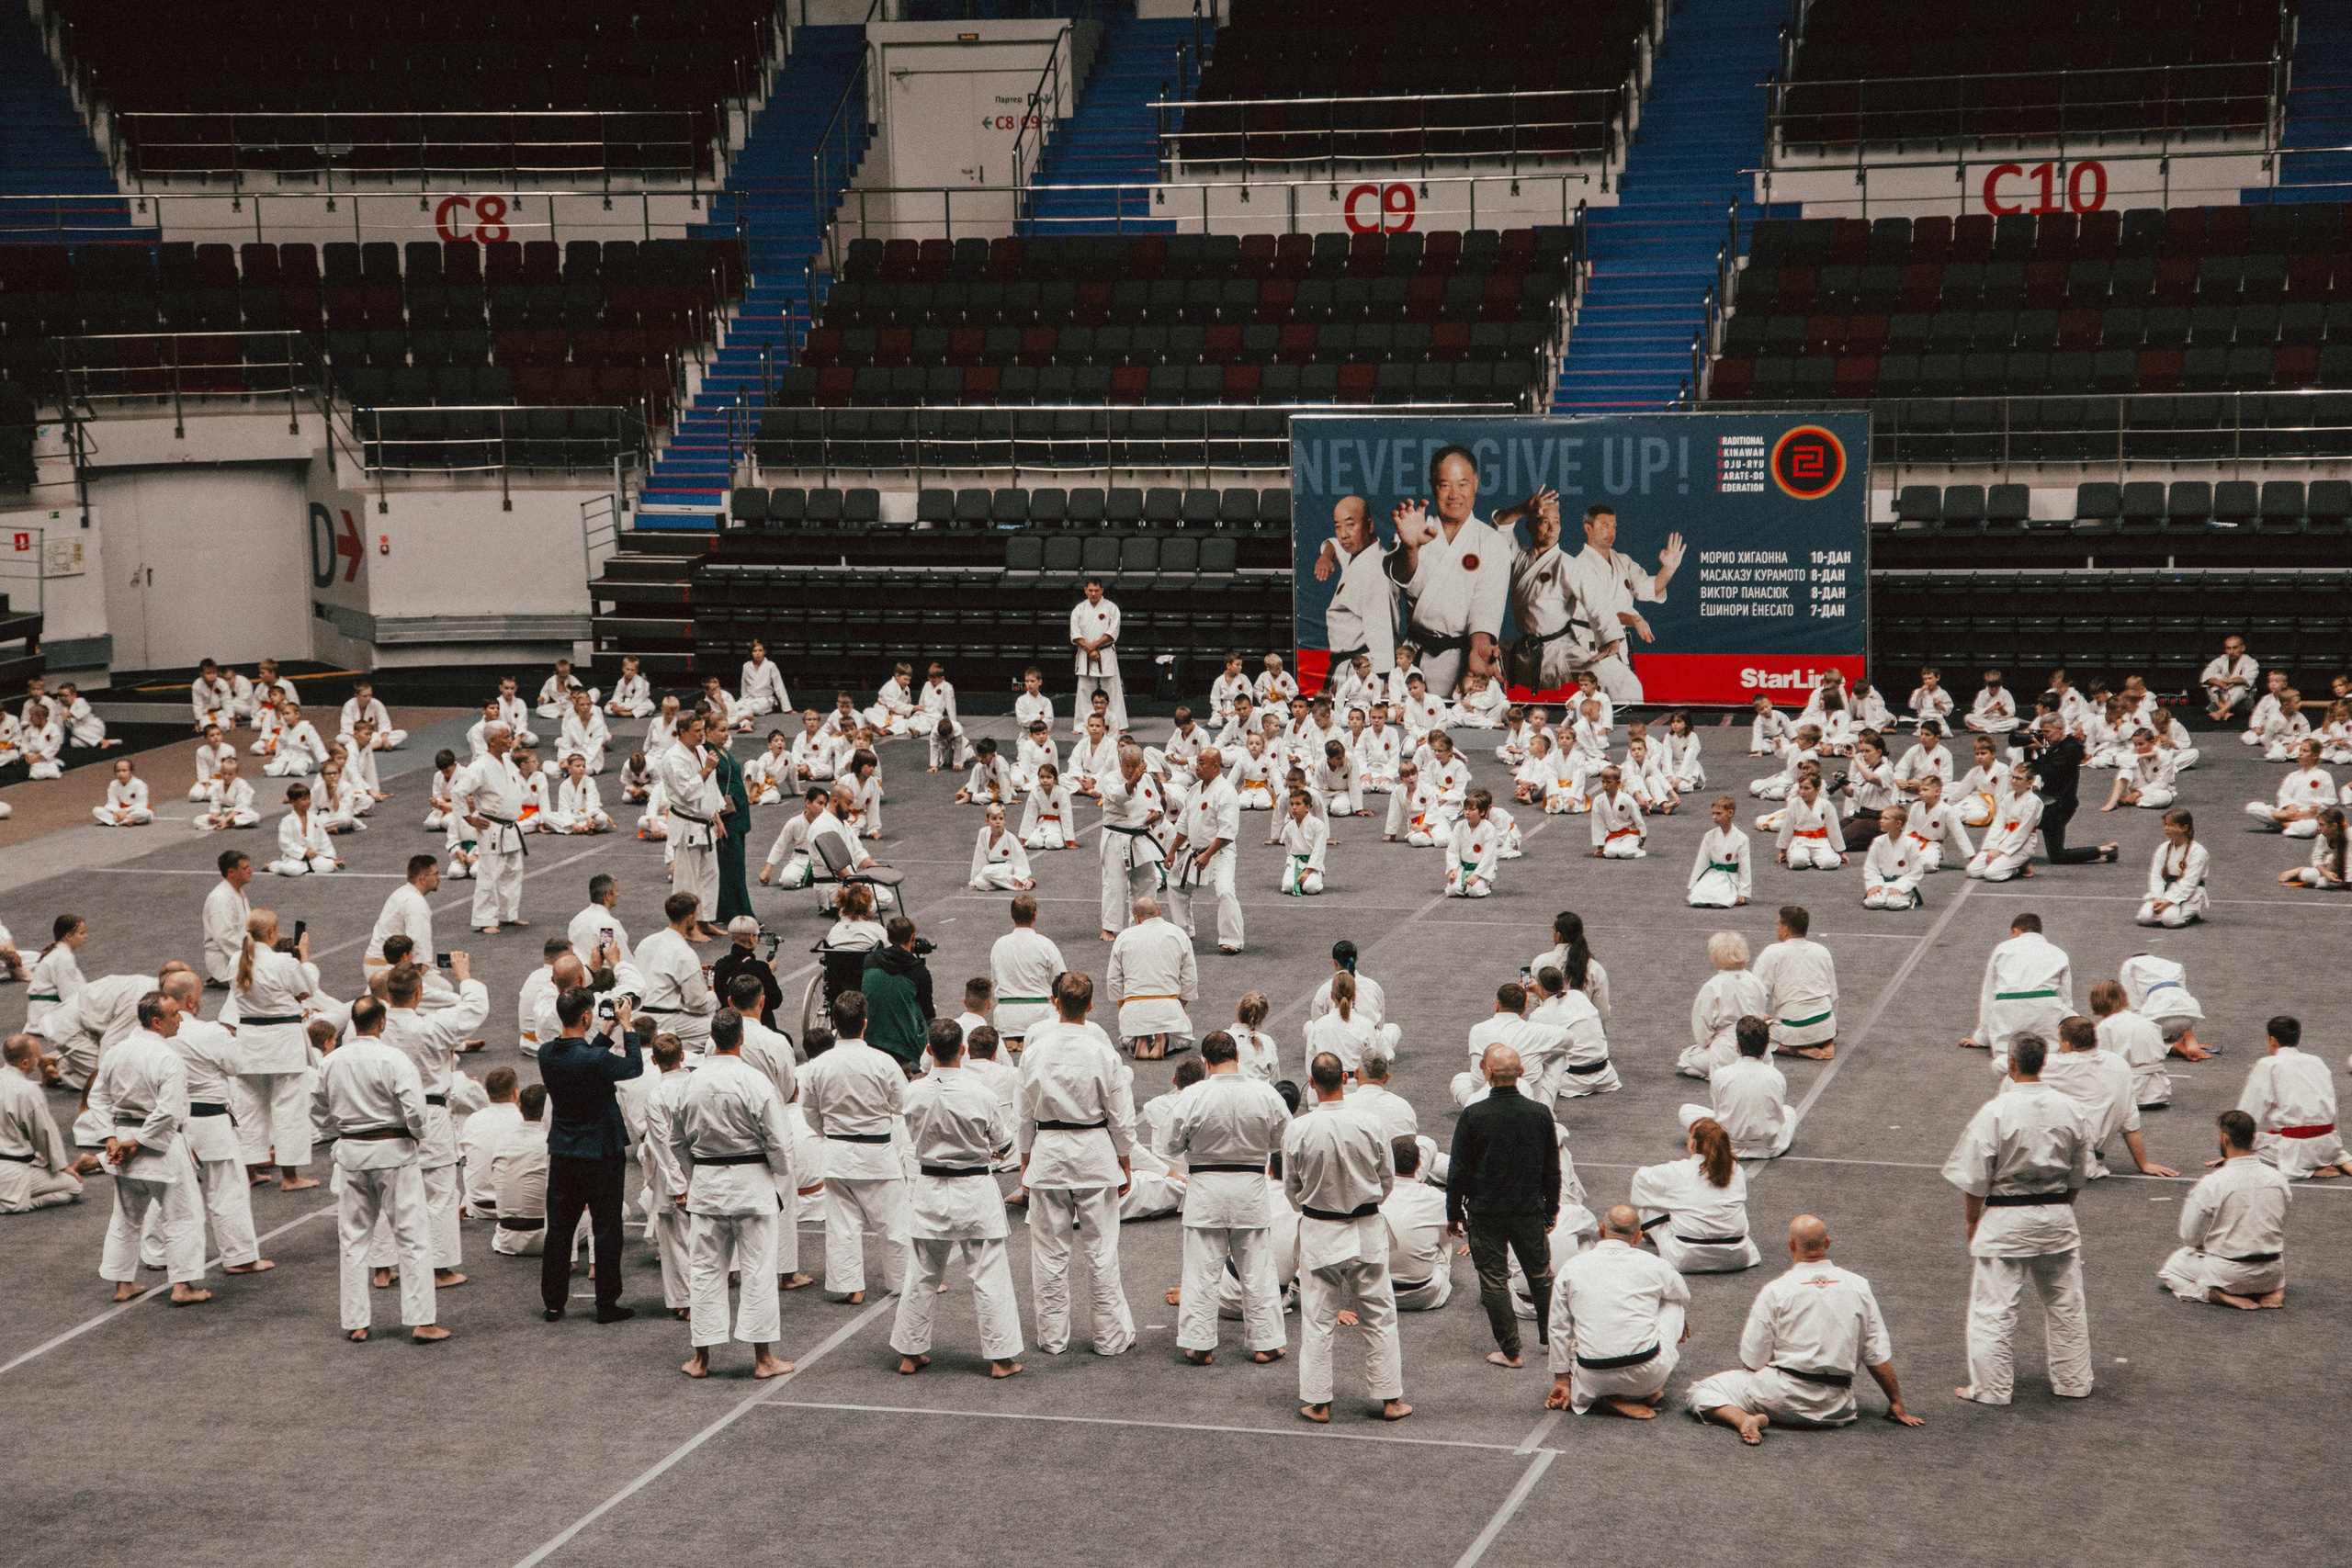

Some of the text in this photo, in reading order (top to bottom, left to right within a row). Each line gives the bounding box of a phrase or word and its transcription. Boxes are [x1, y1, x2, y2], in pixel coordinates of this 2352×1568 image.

[995, 96, 1023, 104] Партер
[995, 116, 1040, 130] C8 C9
[1983, 160, 2108, 217] C10
[1344, 183, 1416, 234] C9
[435, 195, 510, 244] C8
[1718, 435, 1765, 446] TRADITIONAL
[1717, 447, 1765, 457] OKINAWAN
[1472, 436, 1584, 496] GIVE
[1602, 436, 1689, 495] UP!
[1717, 459, 1765, 469] GOJU-RYU
[1717, 470, 1765, 480] KARATE-DO
[1717, 482, 1764, 492] FEDERATION
[309, 502, 336, 588] D
[1701, 551, 1851, 565] МОРИО ХИГАОННА 10-ДАН
[1701, 569, 1846, 583] МАСАКАЗУ КУРАМОТО 8-ДАН
[1701, 586, 1846, 601] ВИКТОР ПАНАСЮК 8-ДАН
[1701, 602, 1845, 618] ЁШИНОРИ ЁНЕСАТО 7-ДАН
[1740, 667, 1846, 689] StarLi
